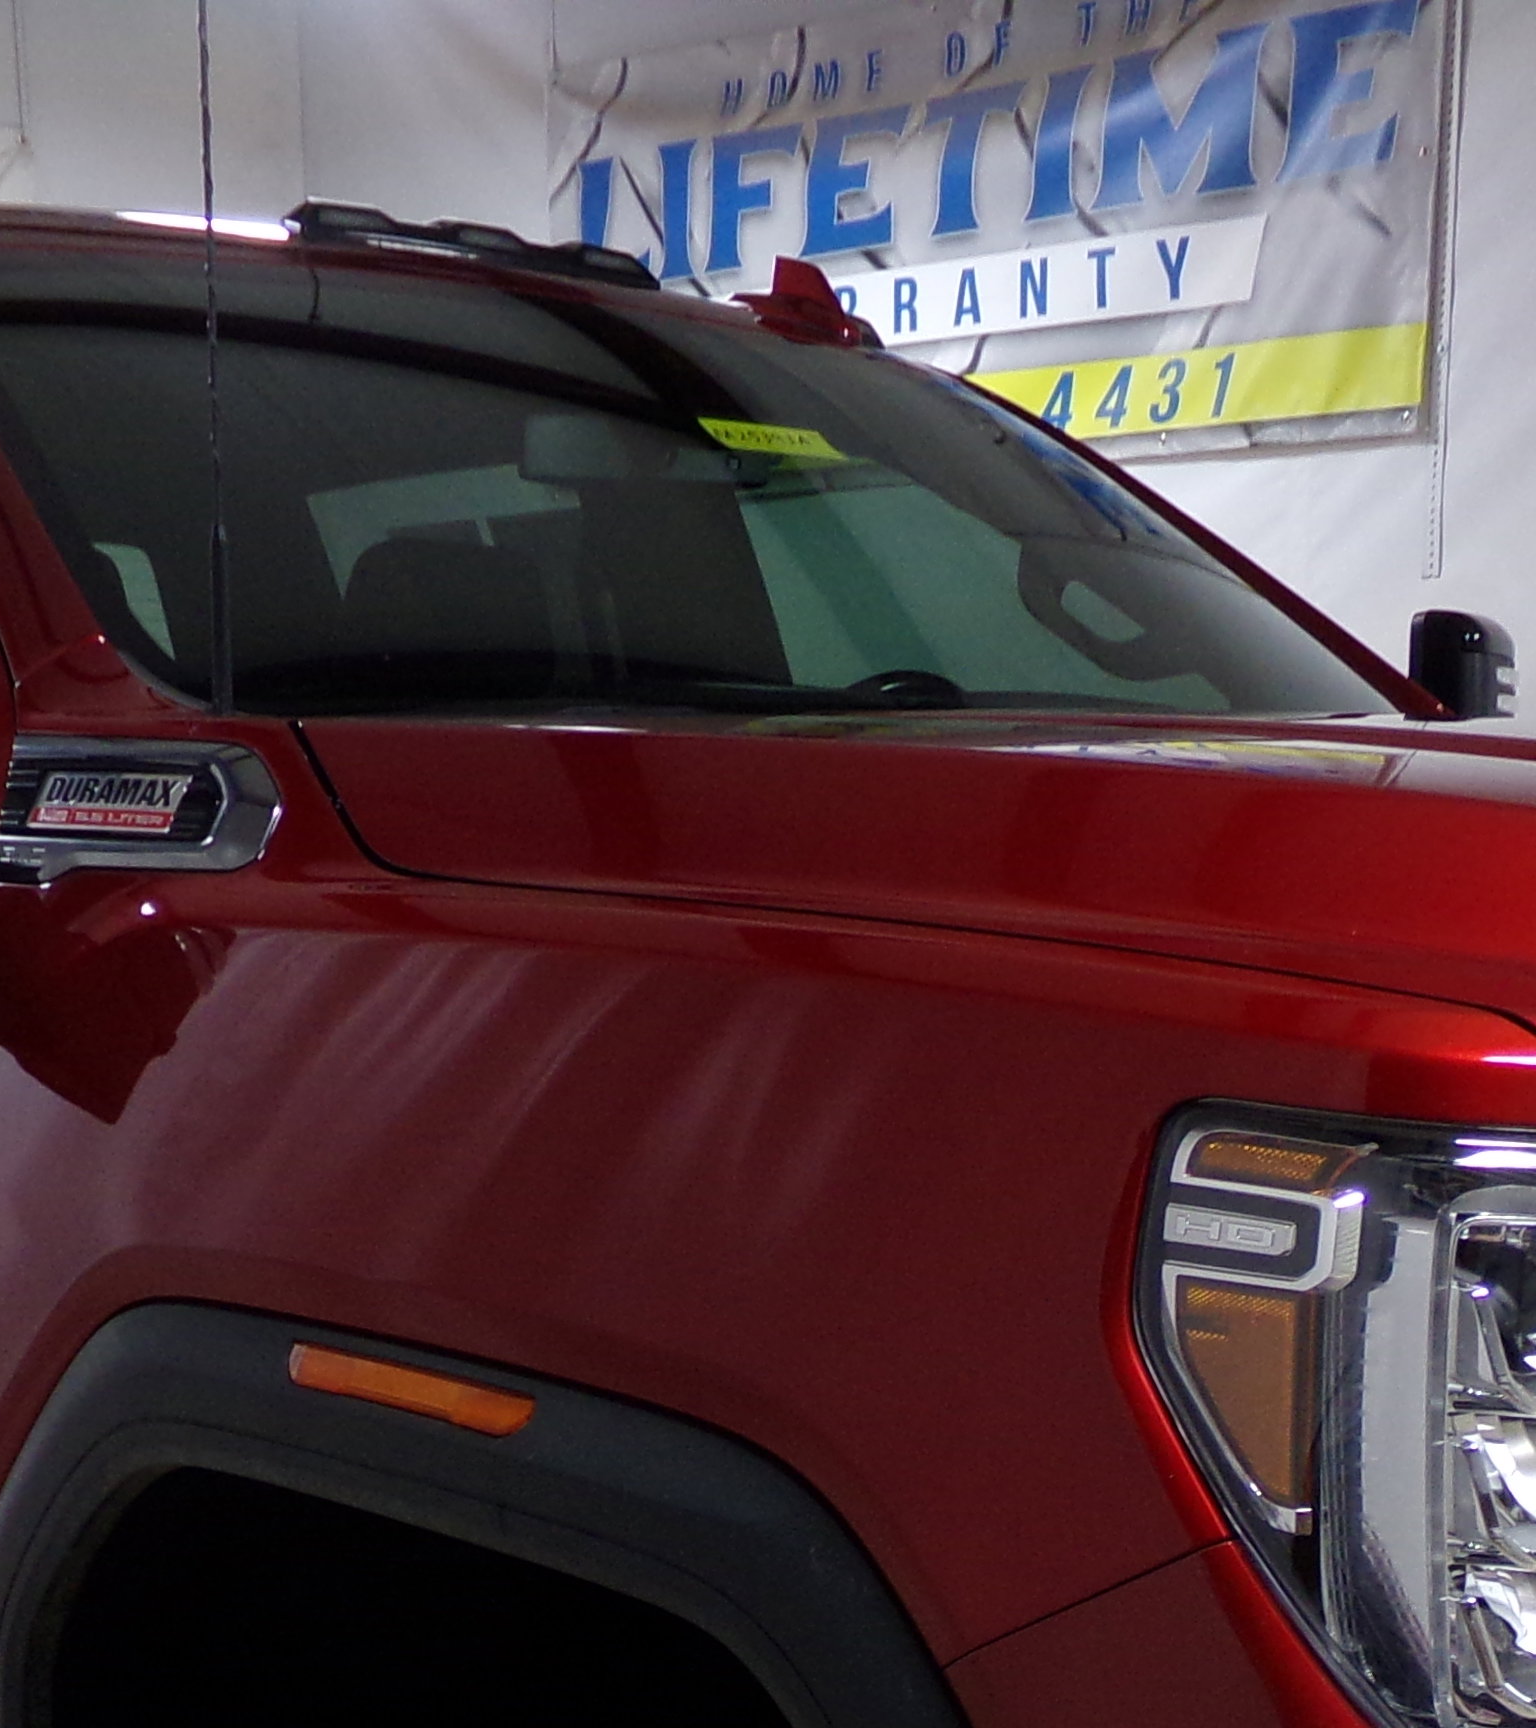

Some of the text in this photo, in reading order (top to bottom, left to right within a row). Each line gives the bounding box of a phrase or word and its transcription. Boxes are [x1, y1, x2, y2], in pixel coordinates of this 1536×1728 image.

[721, 50, 884, 116] HOME
[944, 20, 1012, 78] OF
[576, 0, 1421, 282] LIFETIME
[1041, 352, 1236, 432] 4431
[47, 775, 179, 807] DURAMAX
[1175, 1214, 1275, 1249] HD
